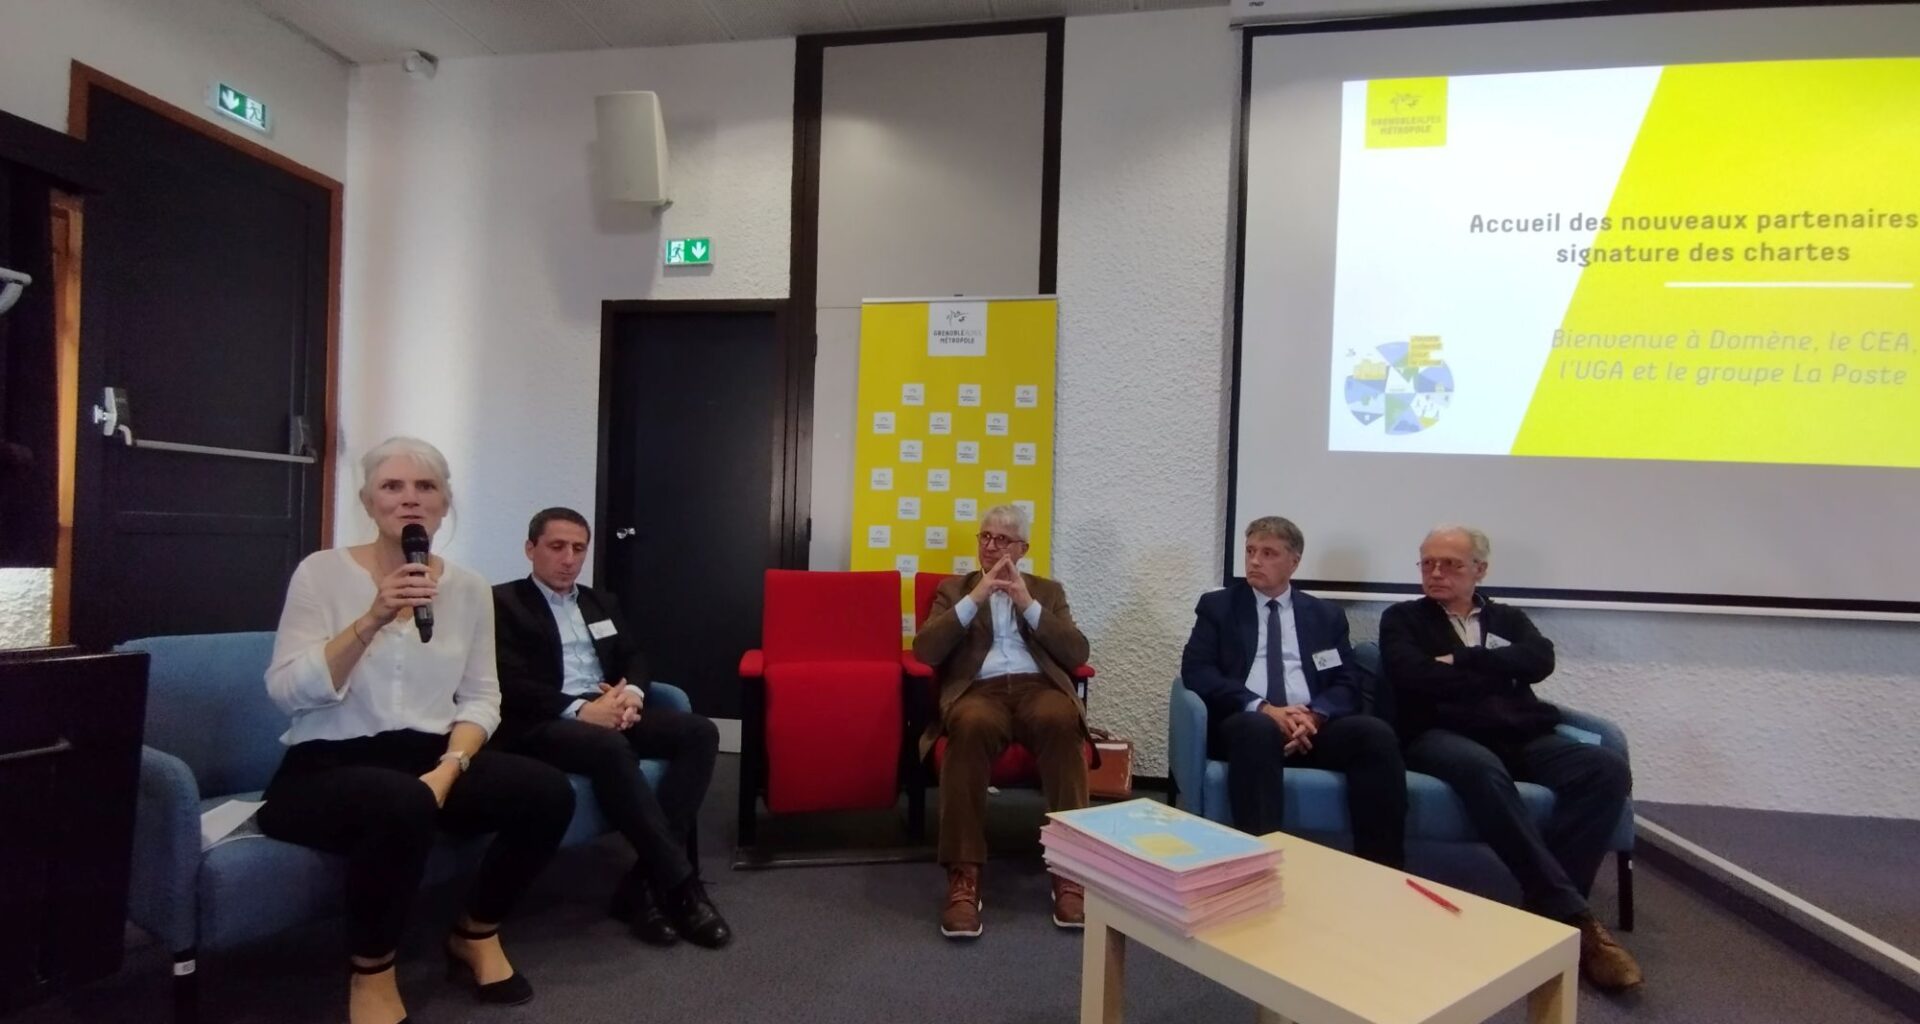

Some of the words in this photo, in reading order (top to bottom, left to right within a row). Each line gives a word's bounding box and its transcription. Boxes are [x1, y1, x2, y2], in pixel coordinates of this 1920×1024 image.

[1469, 212, 1561, 234] Accueil
[1569, 212, 1613, 232] des
[1621, 214, 1748, 231] nouveaux
[1756, 208, 1919, 234] partenaires
[1556, 243, 1680, 267] signature
[1689, 242, 1735, 262] des
[1743, 241, 1851, 262] chartes
[1551, 328, 1679, 349] Bienvenue
[1686, 329, 1701, 350] à
[1709, 329, 1819, 352] Domène,
[1829, 331, 1852, 351] le
[1860, 331, 1917, 355] CEA,
[1559, 360, 1625, 381] l'UGA
[1632, 362, 1659, 381] et
[1666, 362, 1688, 381] le
[1695, 365, 1785, 387] groupe
[1792, 363, 1822, 383] La
[1831, 363, 1908, 385] Poste
